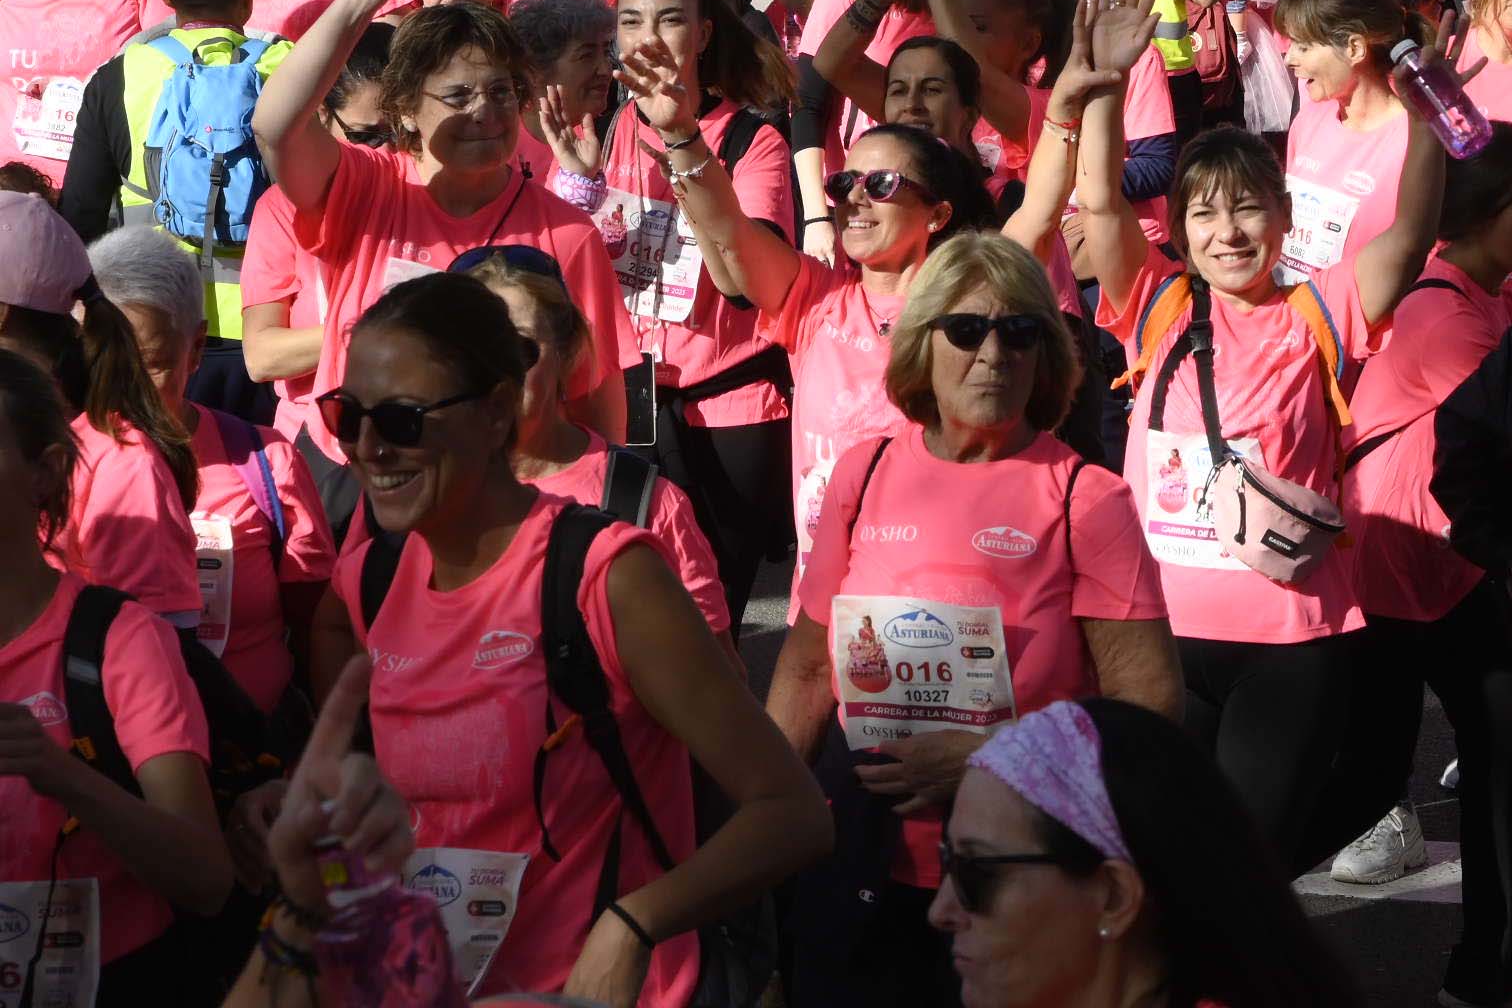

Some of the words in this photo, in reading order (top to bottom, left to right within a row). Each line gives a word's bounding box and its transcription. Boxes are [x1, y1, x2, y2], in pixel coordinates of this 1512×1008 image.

[9, 49, 37, 69] TU
[861, 525, 917, 542] OYSHO
[196, 539, 220, 549] UMA
[977, 535, 1034, 552] ASTURIANA
[890, 623, 950, 641] ASTURIANA
[957, 626, 990, 636] SUMA
[474, 643, 528, 663] ASTURIANA
[896, 661, 953, 682] 016
[904, 690, 949, 702] 10327
[864, 705, 909, 717] CARRERA
[927, 709, 940, 717] LA
[942, 710, 972, 722] MUJER
[863, 725, 912, 739] OYSHO
[469, 874, 505, 886] SUMA
